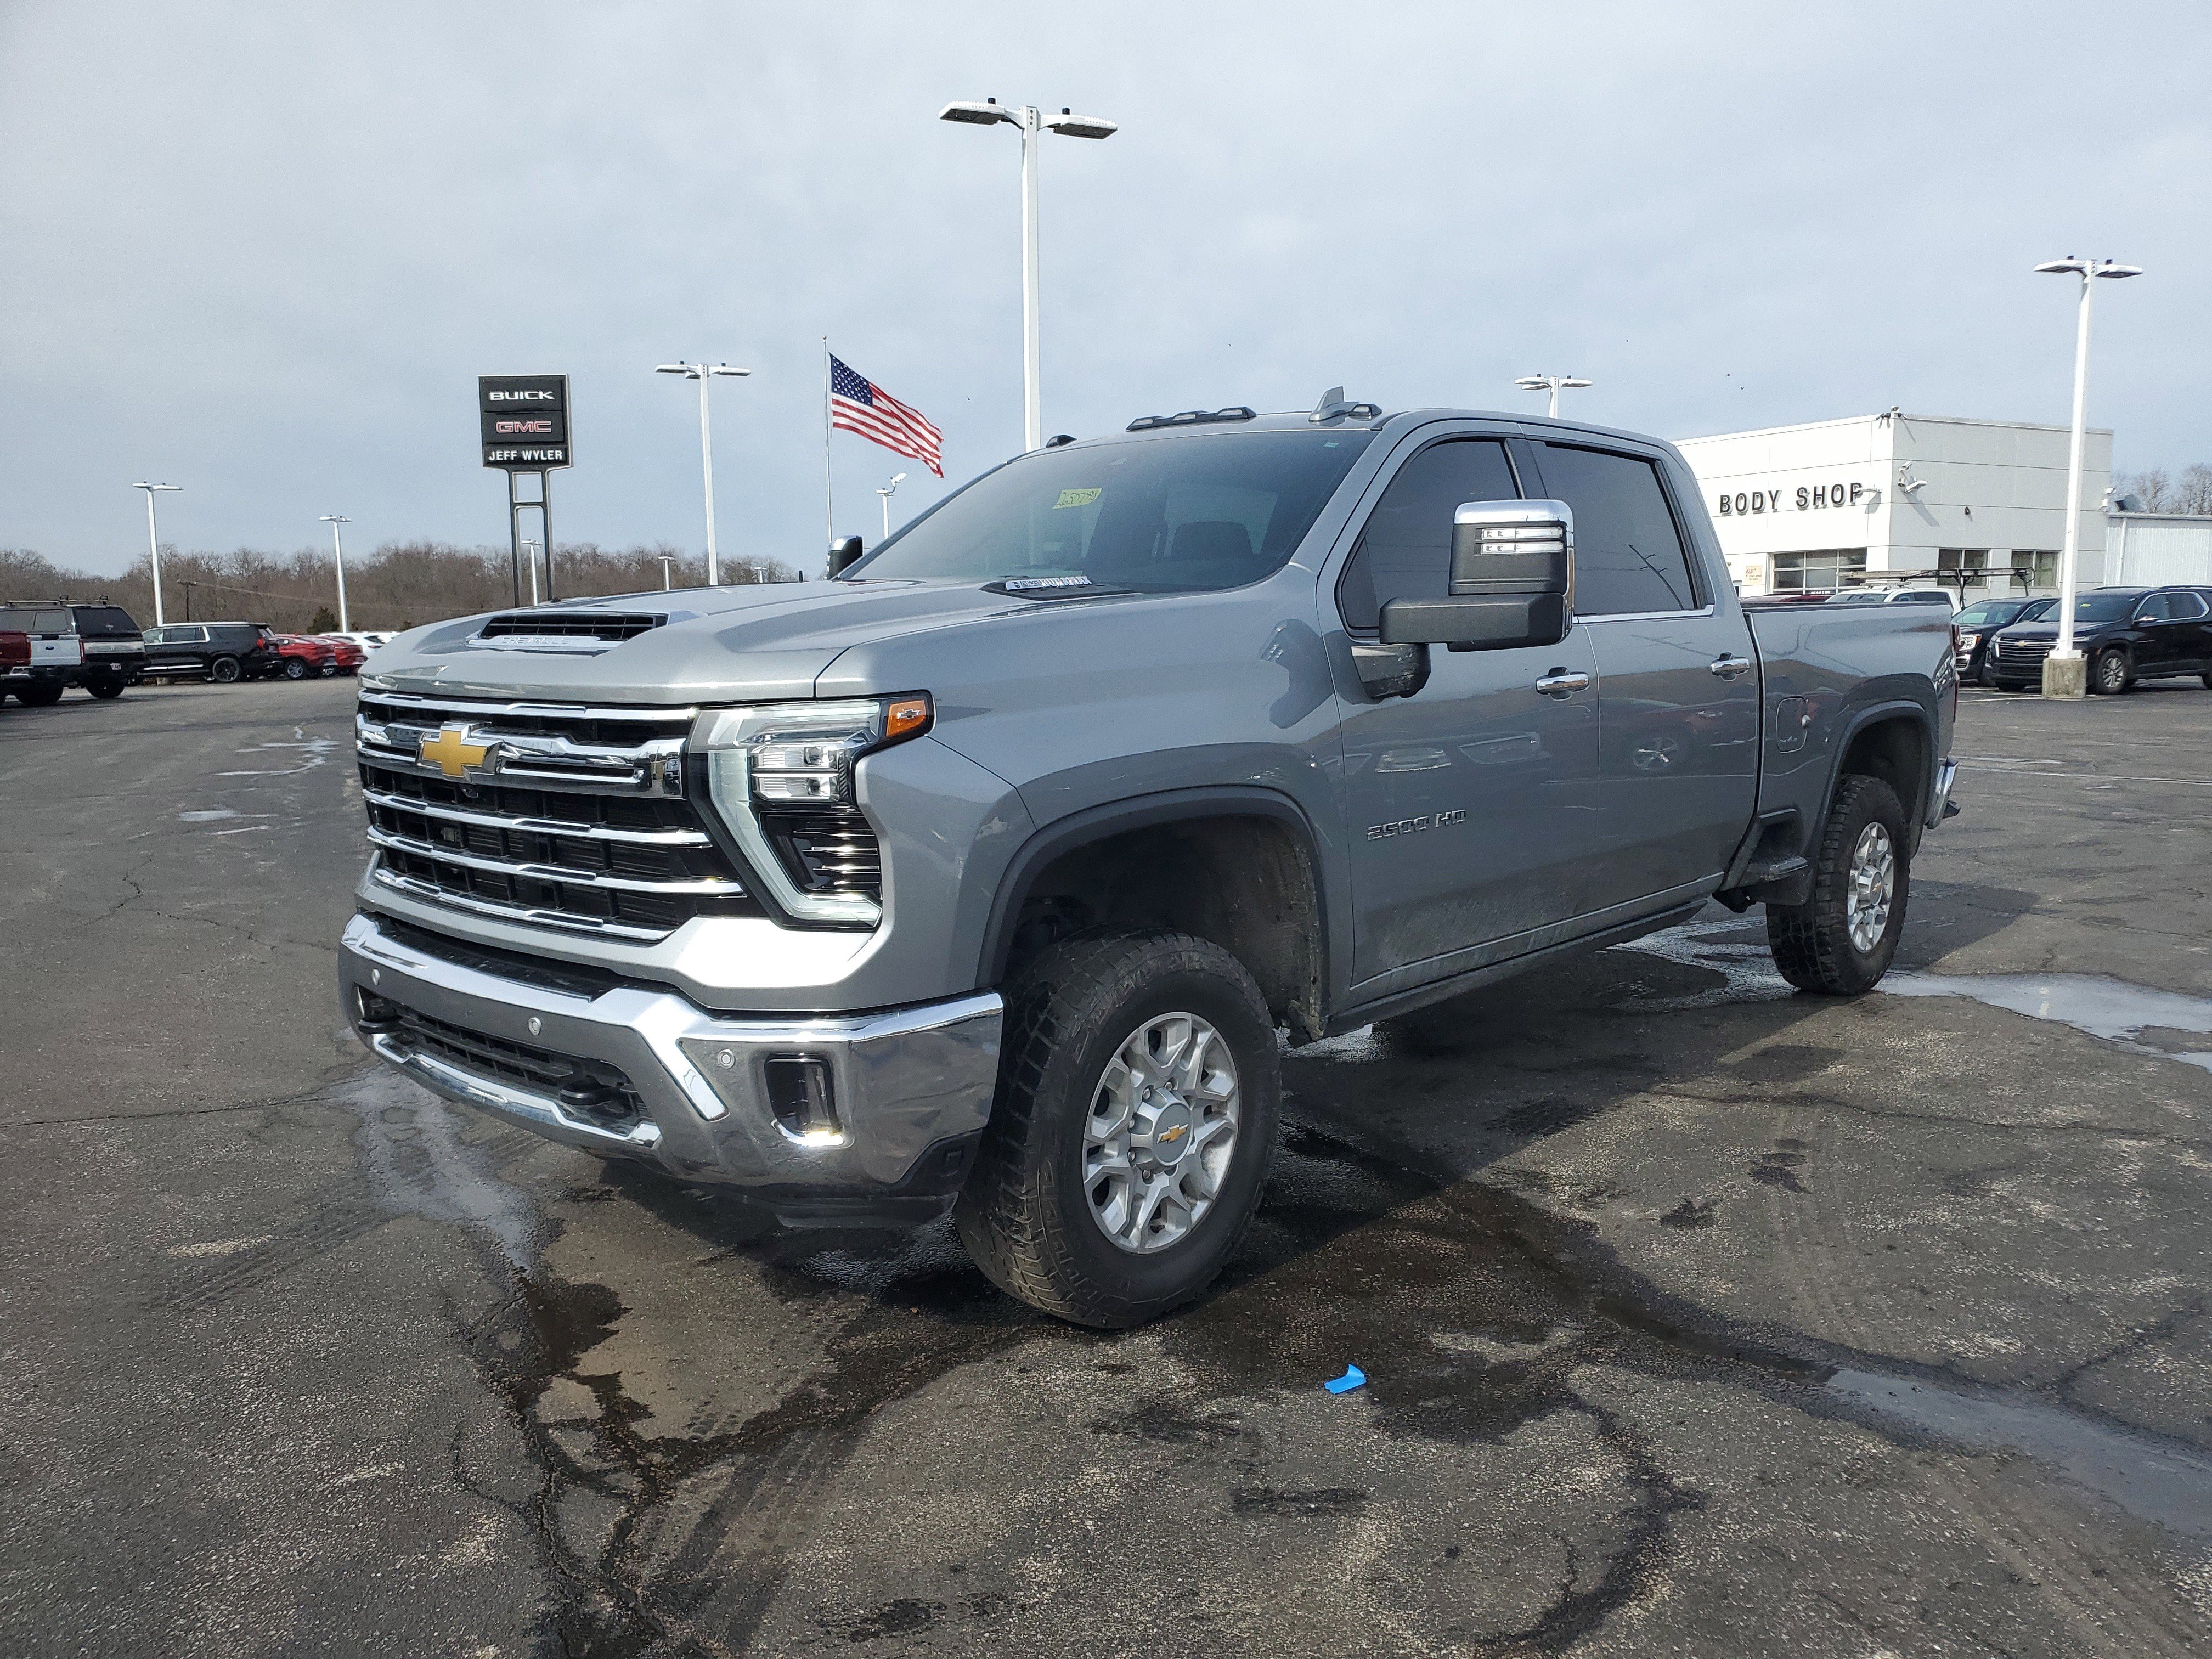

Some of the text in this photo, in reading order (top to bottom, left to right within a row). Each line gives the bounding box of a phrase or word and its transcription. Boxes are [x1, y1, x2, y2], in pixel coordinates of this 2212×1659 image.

[489, 391, 555, 400] BUICK
[496, 420, 552, 433] GMC
[489, 450, 563, 461] JEFF WYLER
[1720, 482, 1864, 515] BODY SHOP
[1368, 809, 1466, 841] 2500 HD
